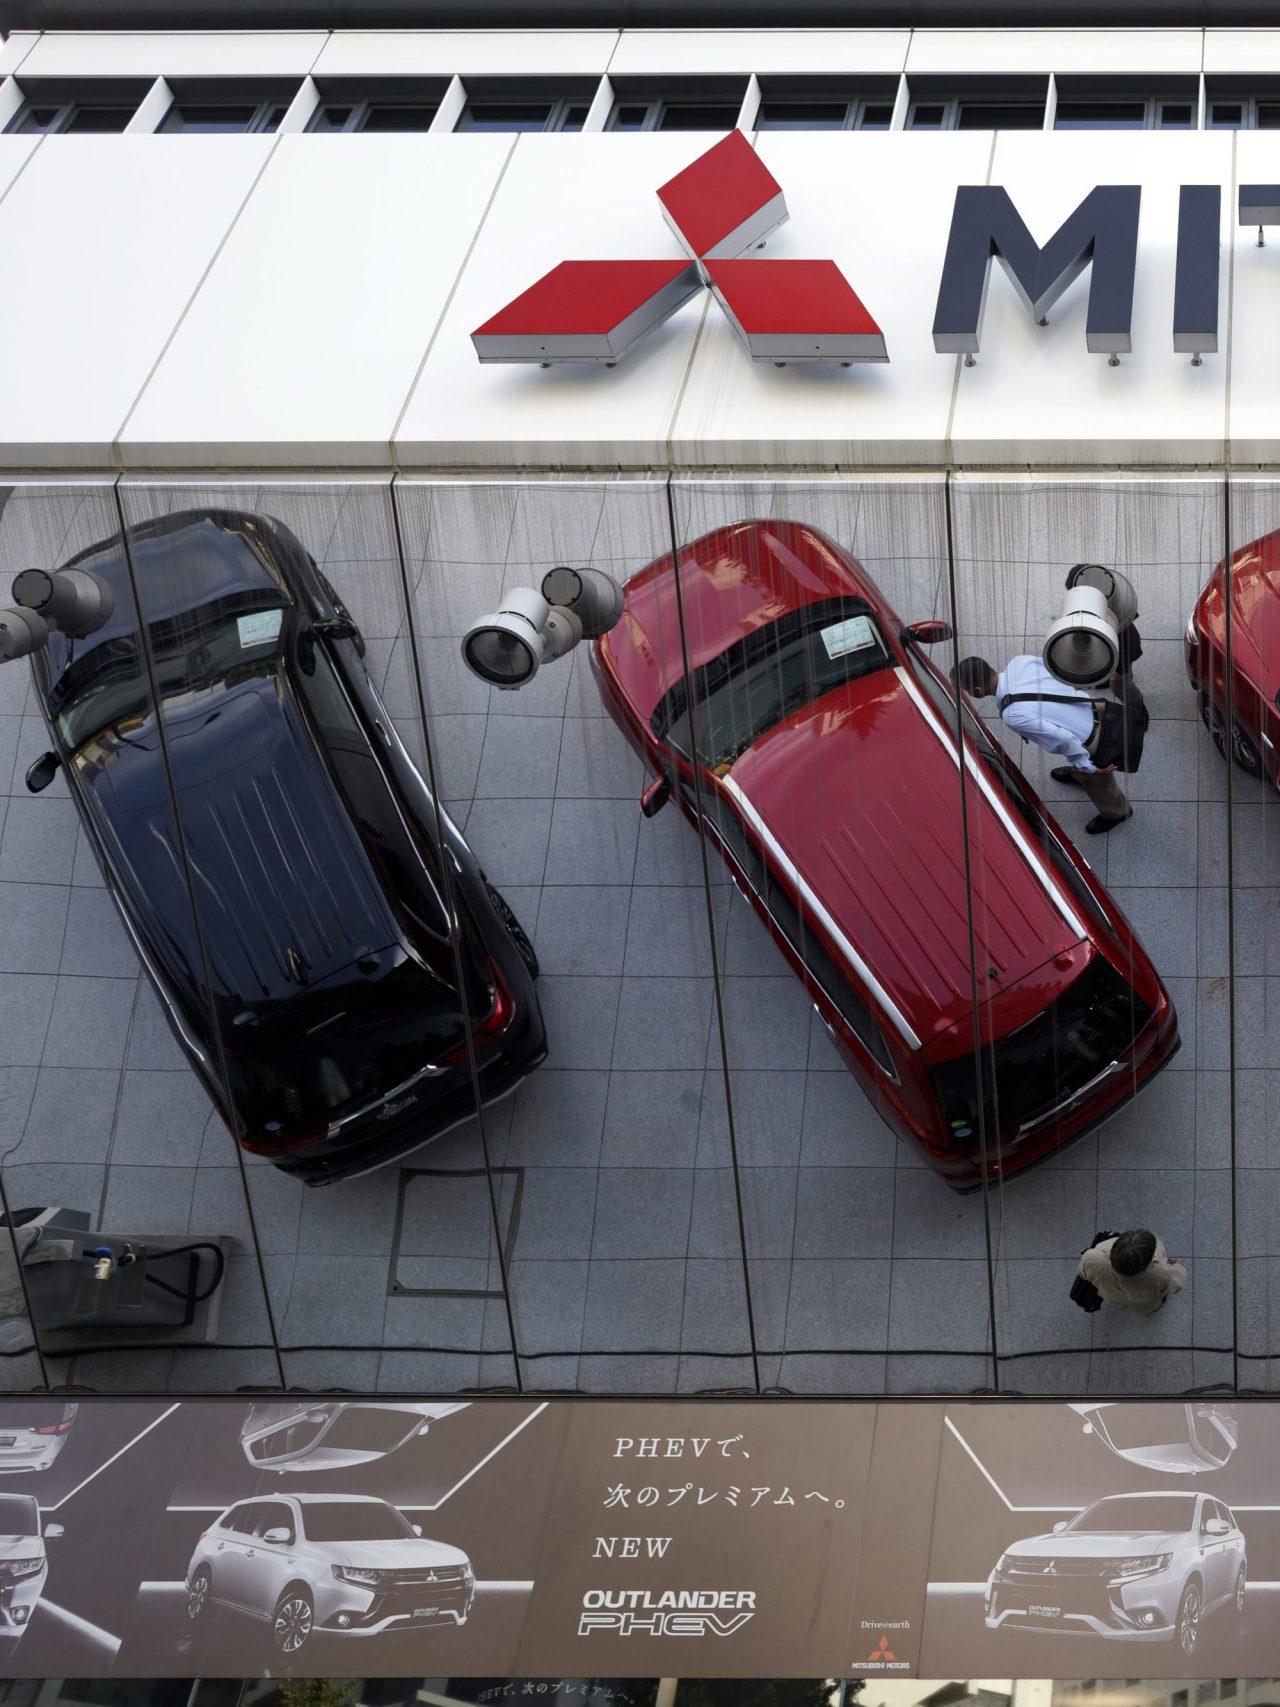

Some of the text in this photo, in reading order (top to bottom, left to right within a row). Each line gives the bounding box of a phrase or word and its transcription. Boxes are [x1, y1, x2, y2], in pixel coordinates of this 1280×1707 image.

[612, 1433, 751, 1459] PHEVで、
[603, 1482, 846, 1509] 次のプレミアムへ。
[592, 1537, 673, 1558] NEW
[582, 1590, 757, 1609] OUTLANDER
[577, 1612, 756, 1636] PHEV
